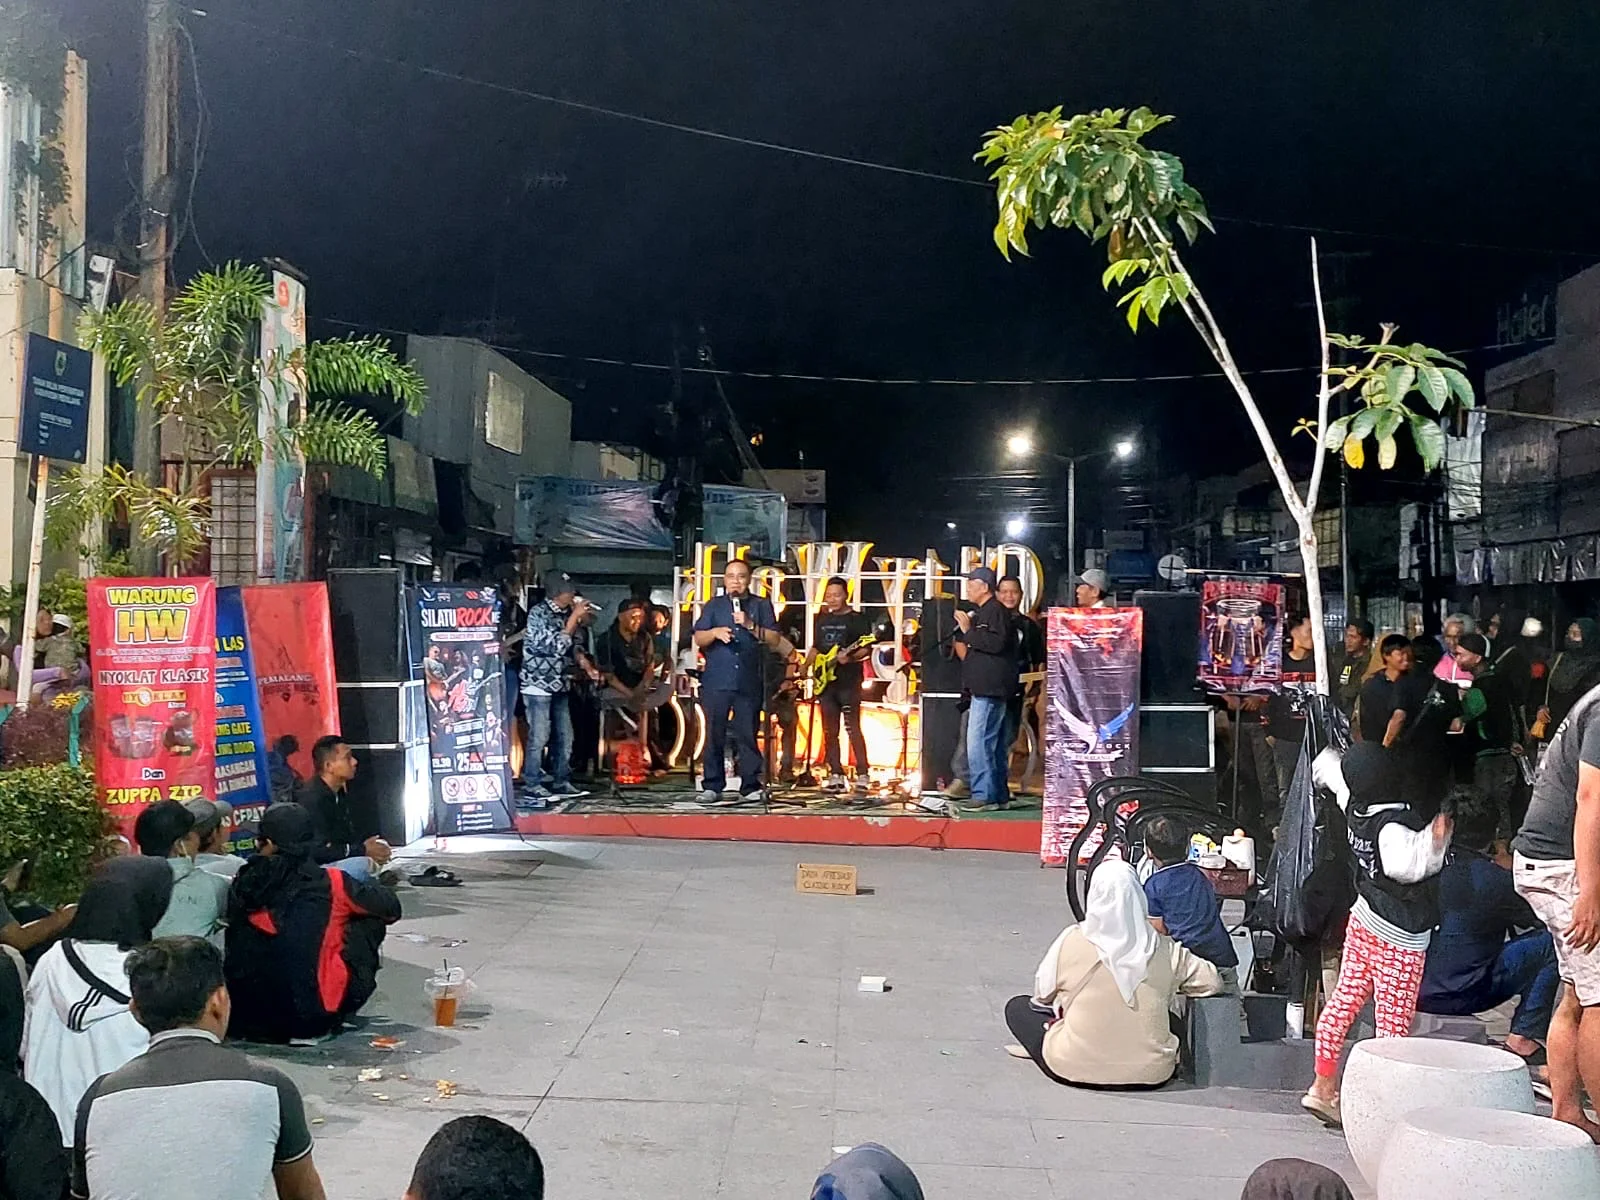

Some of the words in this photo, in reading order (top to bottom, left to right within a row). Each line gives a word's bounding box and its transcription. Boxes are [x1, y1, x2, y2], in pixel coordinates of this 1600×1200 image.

[107, 586, 197, 605] WARUNG
[116, 608, 189, 644] HW
[222, 636, 244, 651] LAS
[99, 670, 156, 685] NYOKLAT
[161, 668, 209, 683] KLASIK
[231, 722, 252, 735] GATE
[1096, 742, 1130, 750] ROCK
[457, 752, 470, 772] 25
[143, 769, 165, 779] Dan
[106, 787, 162, 804] ZUPPA
